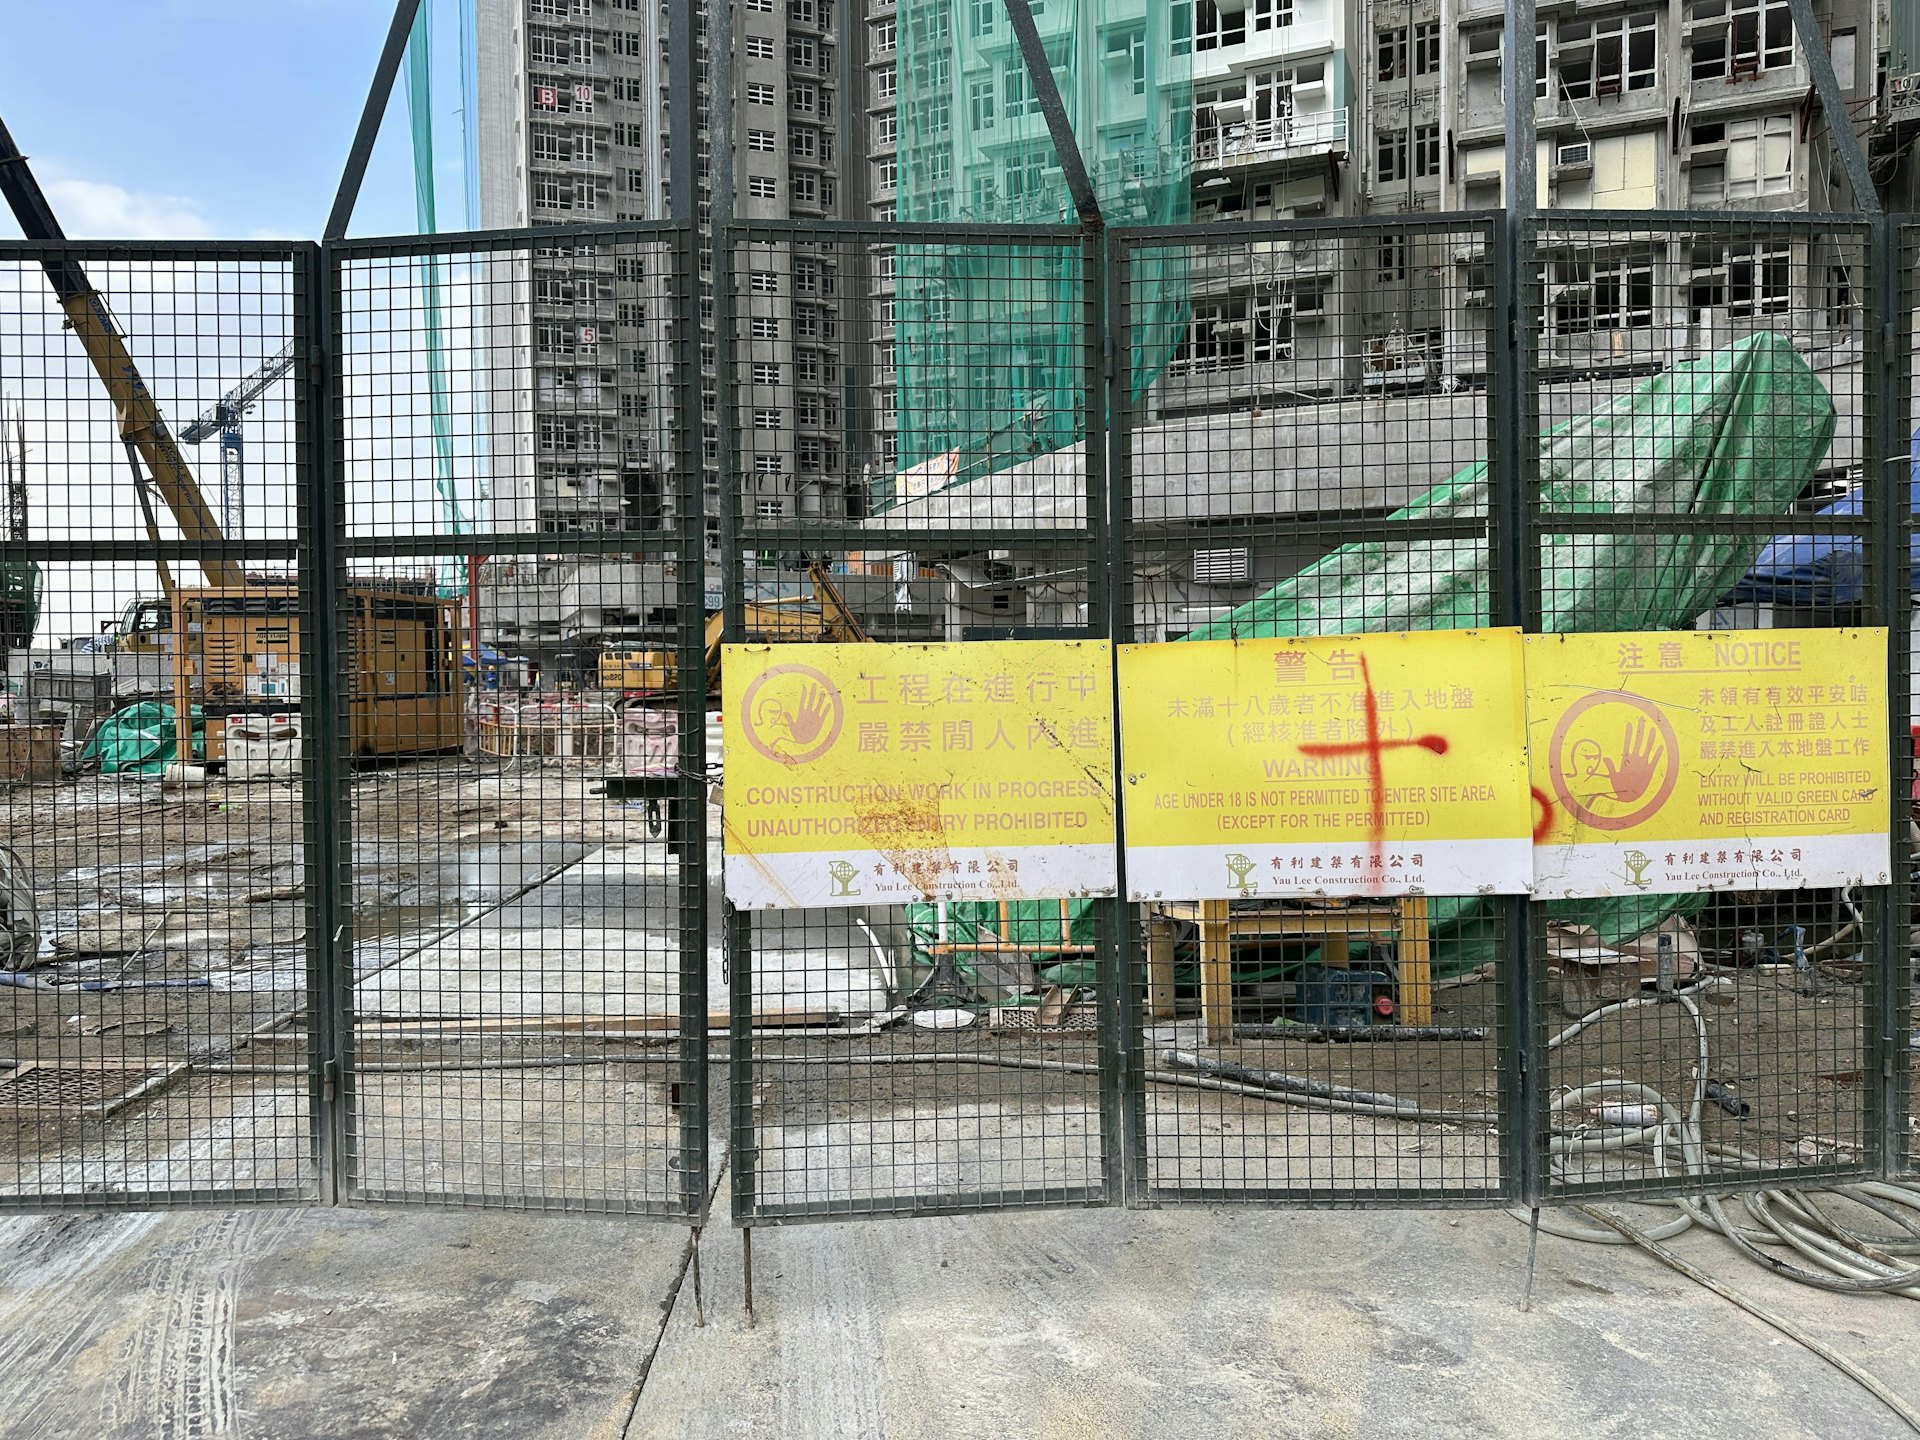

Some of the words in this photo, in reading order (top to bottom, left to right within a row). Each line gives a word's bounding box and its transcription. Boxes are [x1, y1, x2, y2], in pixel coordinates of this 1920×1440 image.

[541, 89, 554, 104] B
[576, 86, 590, 101] 10
[584, 329, 594, 342] 5
[1617, 642, 1683, 669] 注意
[1715, 642, 1801, 666] NOTICE
[1274, 649, 1360, 683] 警告
[857, 672, 1097, 705] 工程在進行中
[1699, 684, 1867, 705] 未領有有效平安咭
[1700, 711, 1868, 733] 及工人註冊證人士
[1700, 738, 1869, 759] 嚴禁進入本地盤工作
[1700, 774, 1740, 788] ENTRY
[1744, 774, 1775, 786] WILL
[1779, 773, 1795, 785] BE
[1799, 771, 1871, 784] PROHIBITED
[747, 784, 901, 805] CONSTRUCTION
[909, 784, 967, 801] WORK
[973, 783, 993, 799] IN
[997, 780, 1102, 799] PROGRESS
[1154, 793, 1179, 808] AGE
[1183, 792, 1225, 808] UNDER
[1229, 792, 1241, 807] 18
[1245, 792, 1256, 806] IS
[1260, 791, 1286, 805] NOT
[1290, 789, 1361, 805] PERMITTED
[1364, 789, 1380, 803] TO
[1386, 787, 1426, 802] ENTER
[1430, 786, 1457, 801] SITE
[1461, 786, 1495, 800] AREA
[1698, 793, 1750, 806] WITHOUT
[1756, 791, 1793, 804] VALID
[1797, 790, 1838, 803] GREEN
[1842, 789, 1873, 802] CARD
[974, 812, 1088, 830] PROHIBITED
[1217, 815, 1276, 831] (EXCEPT
[1281, 812, 1309, 827] FOR
[1315, 811, 1341, 826] THE
[1345, 809, 1429, 826] PERMITTED)
[1700, 812, 1723, 825] AND
[1727, 809, 1814, 824] REGISTRATION
[1818, 808, 1850, 821] CARD
[1272, 854, 1423, 869] 有利建築有限公司
[1665, 849, 1801, 864] 有利建築有限公司
[873, 859, 1020, 876] 有利建築有限公司
[1684, 872, 1699, 880] Lee
[1702, 870, 1759, 879] Construction
[1784, 869, 1802, 877] Ltd.
[875, 882, 893, 892] Yau
[896, 882, 911, 891] Lee
[915, 881, 976, 891] Construction
[1000, 880, 1019, 889] Ltd.
[1273, 876, 1291, 885] Yau
[1295, 876, 1311, 884] Lee
[1315, 875, 1378, 884] Construction
[1405, 875, 1424, 883] Ltd.
